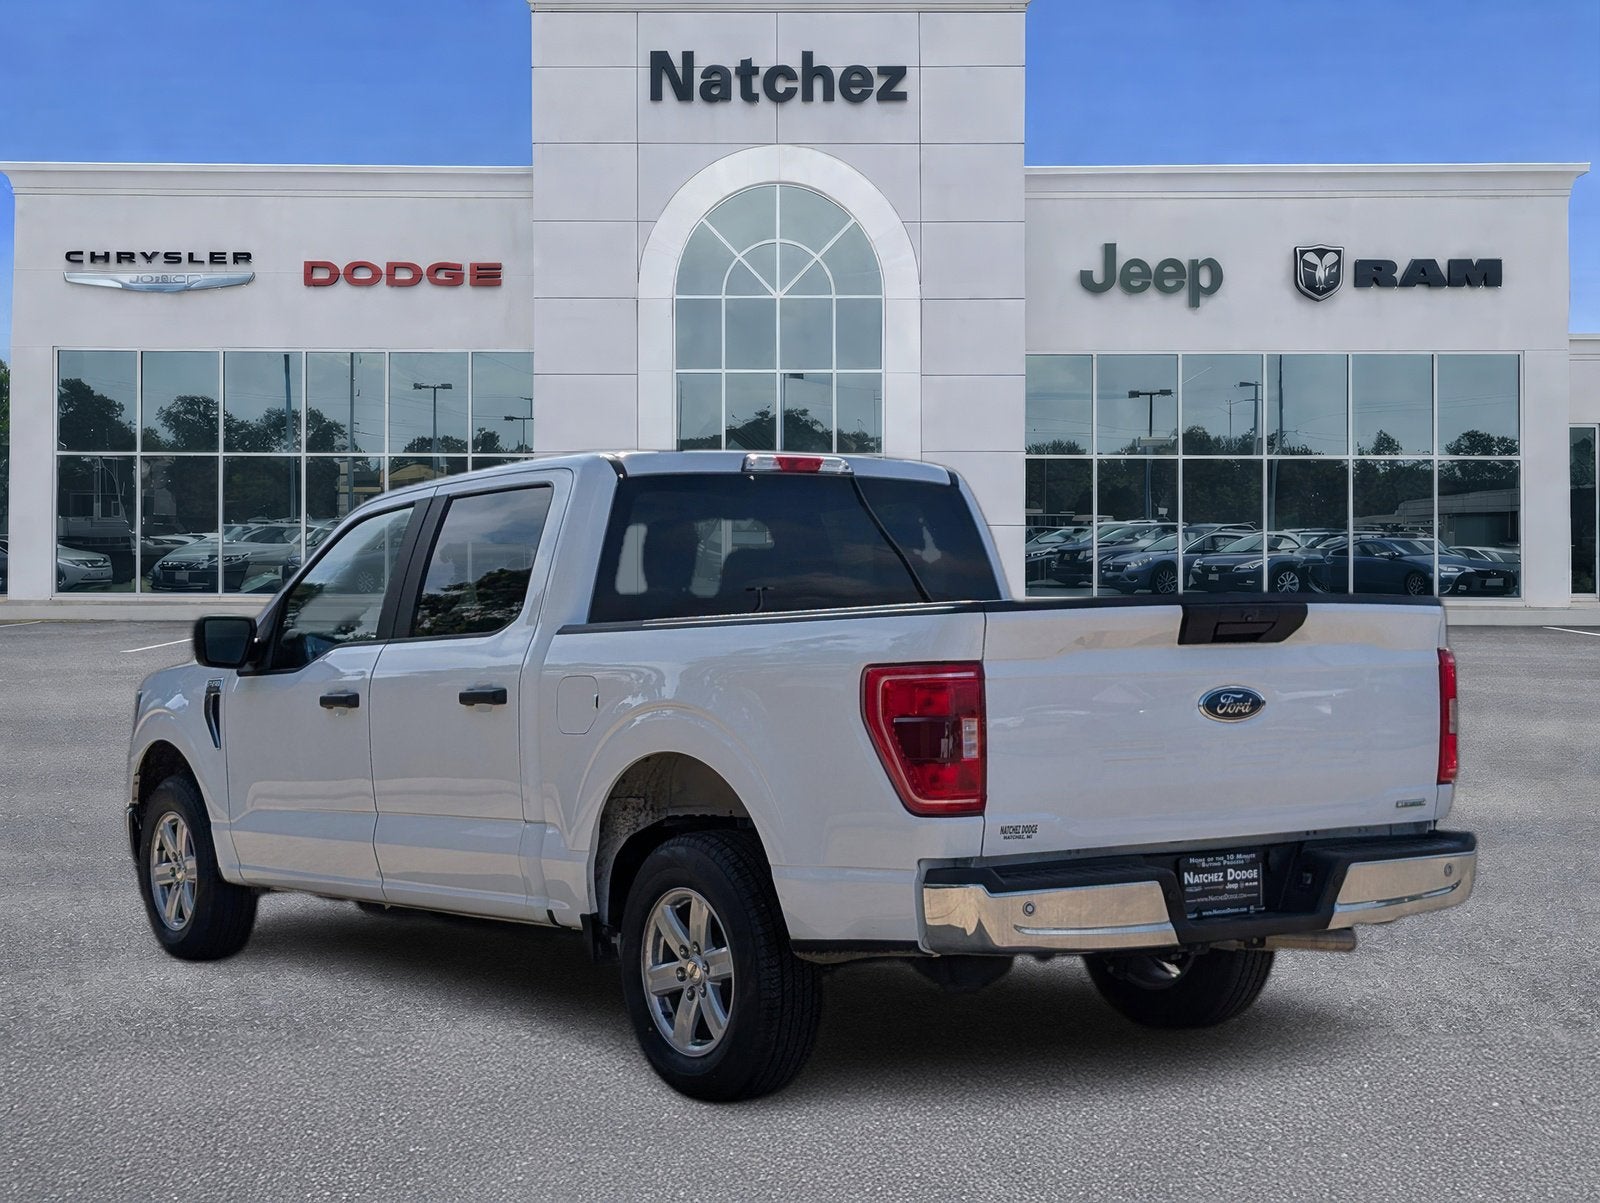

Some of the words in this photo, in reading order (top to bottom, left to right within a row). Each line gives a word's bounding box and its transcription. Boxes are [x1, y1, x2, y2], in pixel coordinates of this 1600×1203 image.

[649, 50, 908, 103] Natchez
[65, 251, 253, 265] CHRYSLER
[304, 261, 502, 287] DODGE
[1080, 243, 1223, 309] Jeep
[1354, 258, 1503, 288] RAM
[1216, 693, 1253, 714] Ford
[1000, 825, 1021, 835] NATCHEZ
[1022, 824, 1038, 834] DODGE
[1183, 871, 1224, 885] NATCHEZ
[1227, 868, 1258, 881] DODGE
[1225, 882, 1239, 890] Jeep
